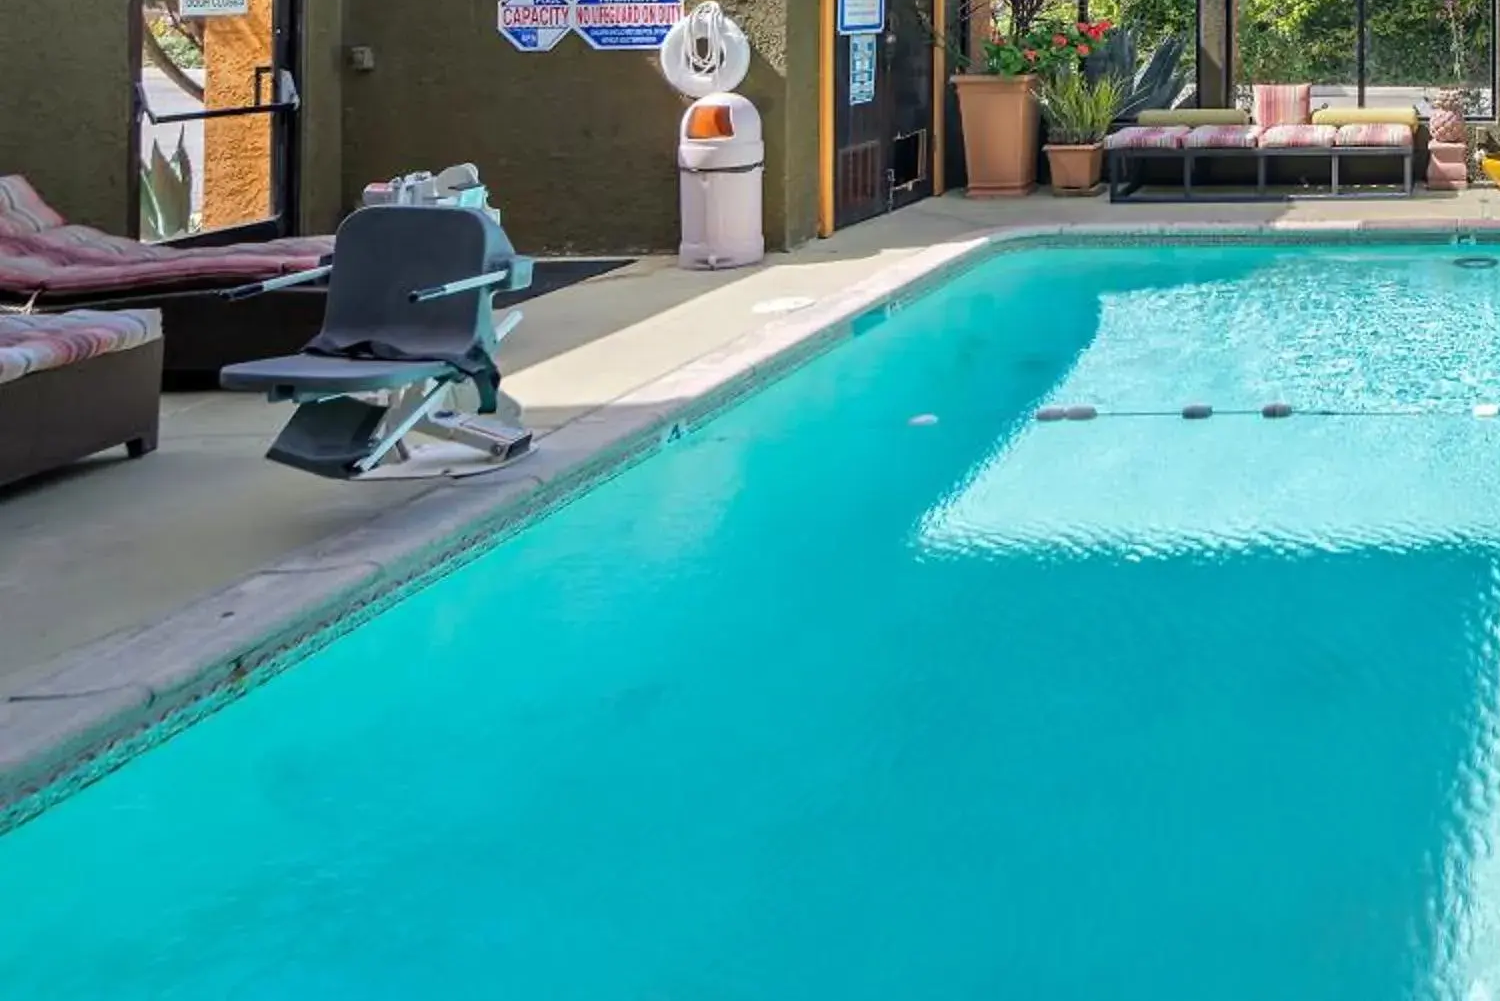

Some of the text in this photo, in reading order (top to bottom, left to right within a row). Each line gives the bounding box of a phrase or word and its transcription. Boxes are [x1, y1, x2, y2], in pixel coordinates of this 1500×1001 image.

[503, 7, 568, 25] CAPACITY
[576, 4, 680, 24] NO LIFEGUARD ON DUTY
